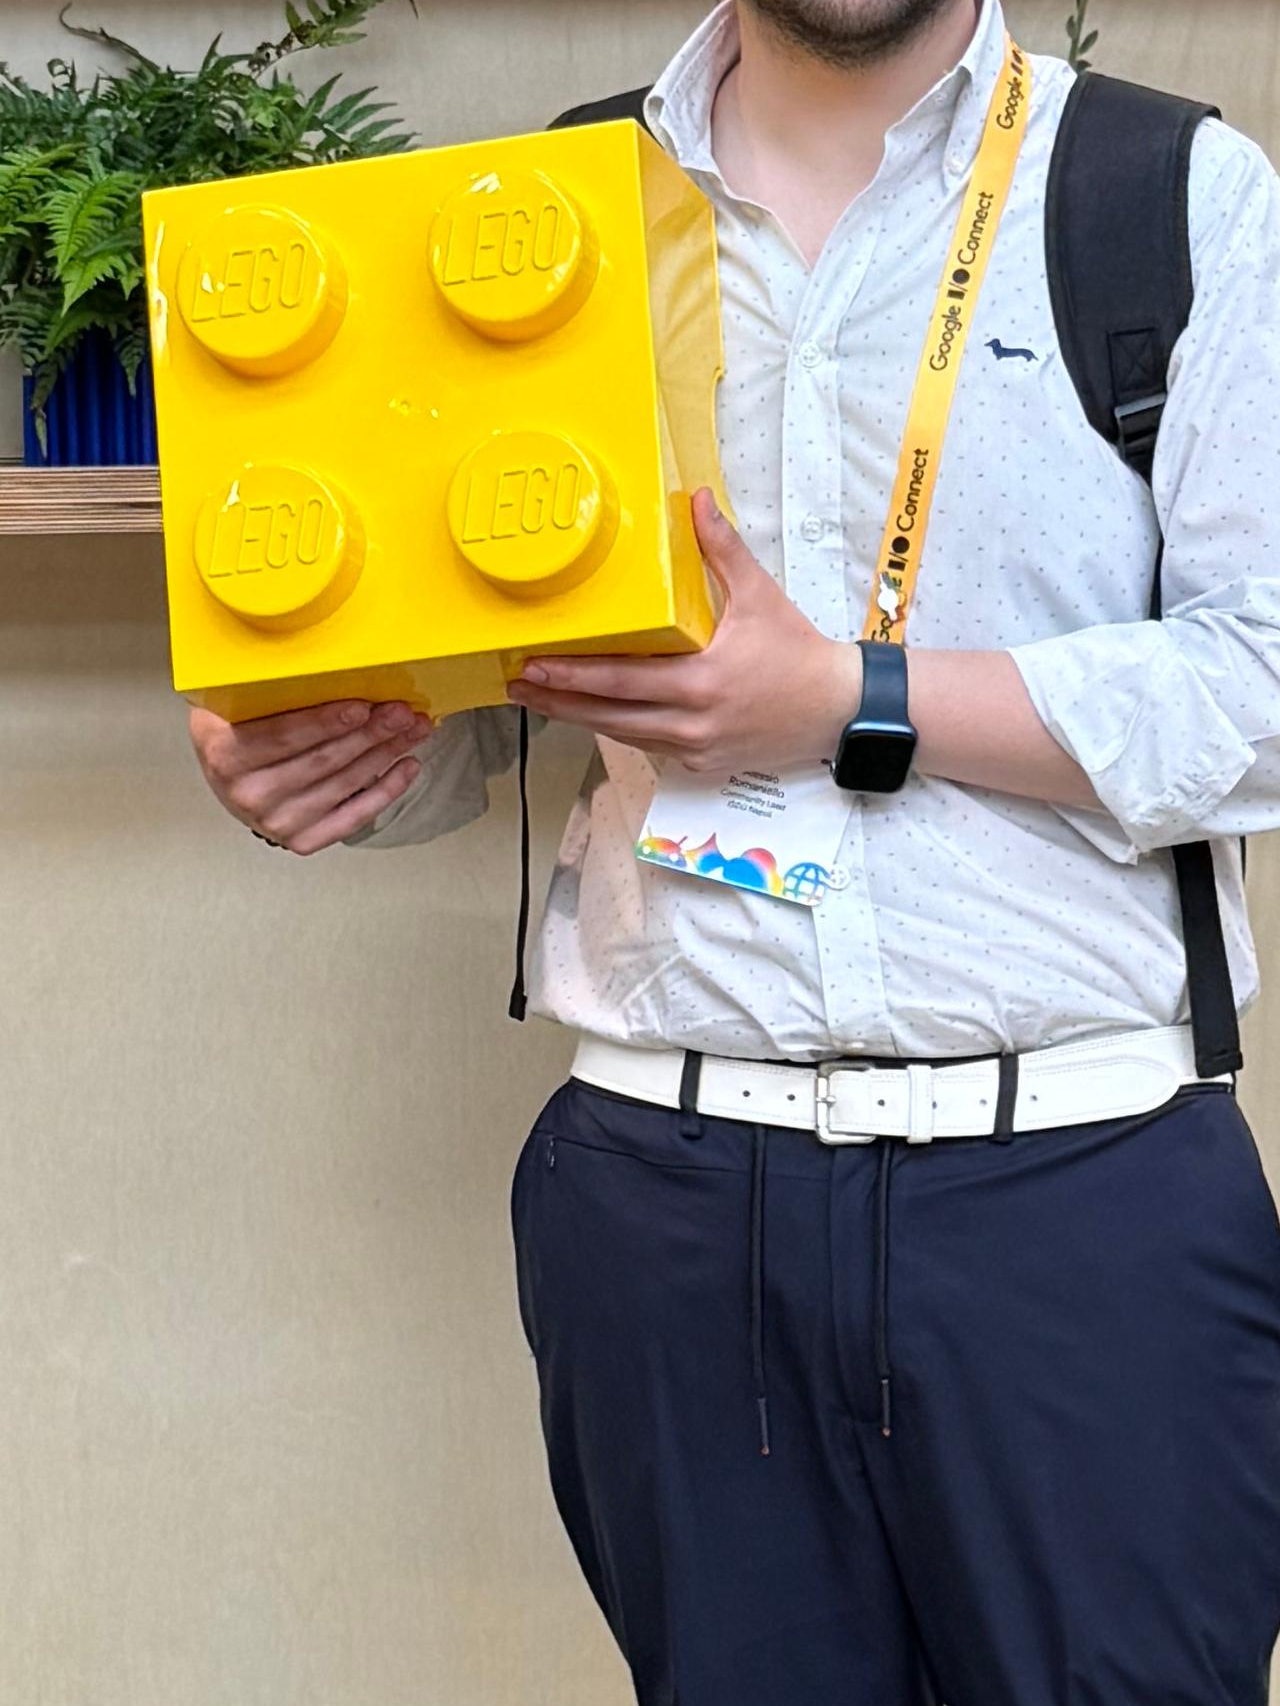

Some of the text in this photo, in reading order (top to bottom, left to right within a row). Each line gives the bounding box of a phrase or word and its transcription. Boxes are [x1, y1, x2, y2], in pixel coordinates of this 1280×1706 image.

[190, 241, 309, 324] LEGO
[441, 203, 560, 286] LEGO
[929, 305, 963, 371] Google
[957, 190, 994, 265] Connect
[461, 462, 580, 544] LEGO
[895, 447, 929, 533] Connect
[207, 497, 325, 579] LEGO
